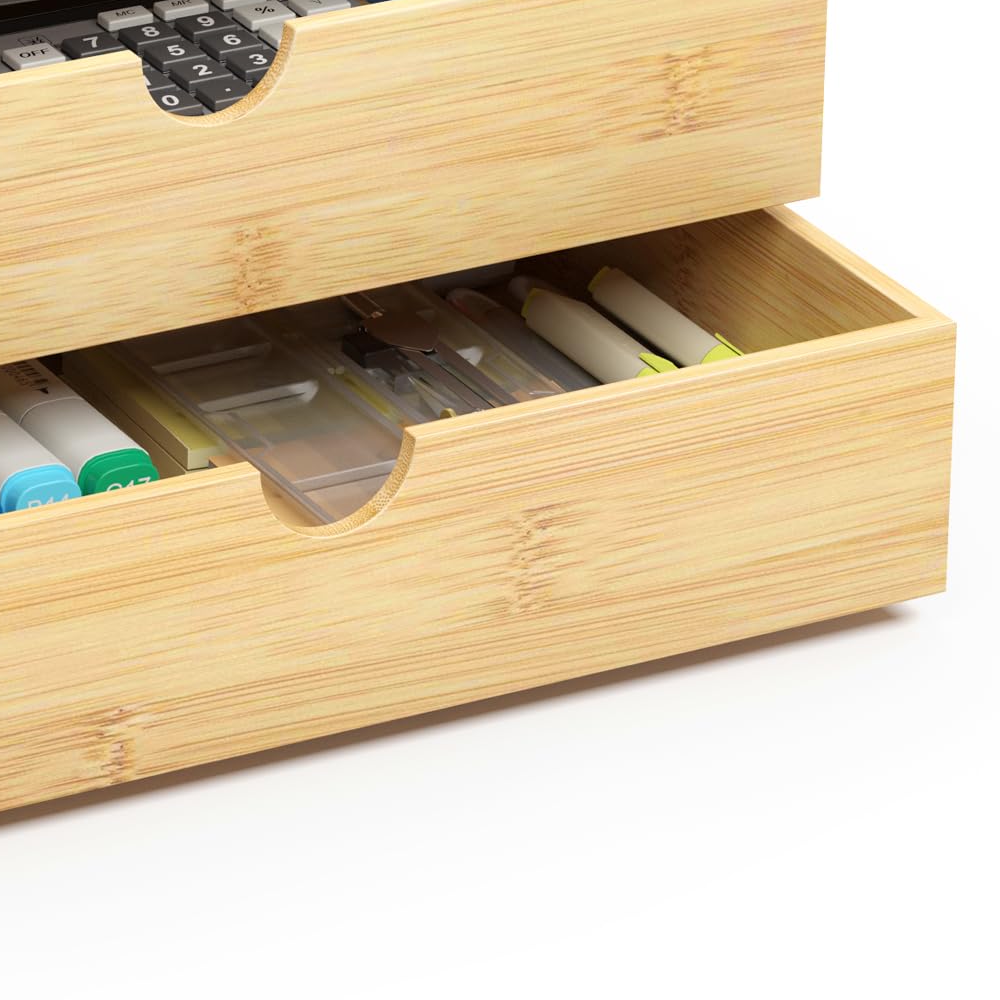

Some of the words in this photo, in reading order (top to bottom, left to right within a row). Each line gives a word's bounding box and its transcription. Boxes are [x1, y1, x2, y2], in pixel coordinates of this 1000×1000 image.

[254, 6, 275, 14] %
[196, 15, 215, 27] 9
[141, 26, 160, 37] 8
[83, 36, 99, 48] 7
[222, 34, 242, 46] 6
[19, 47, 50, 58] OFF
[166, 44, 186, 56] 5
[248, 53, 268, 65] 3
[192, 64, 213, 76] 2
[161, 94, 180, 106] 0
